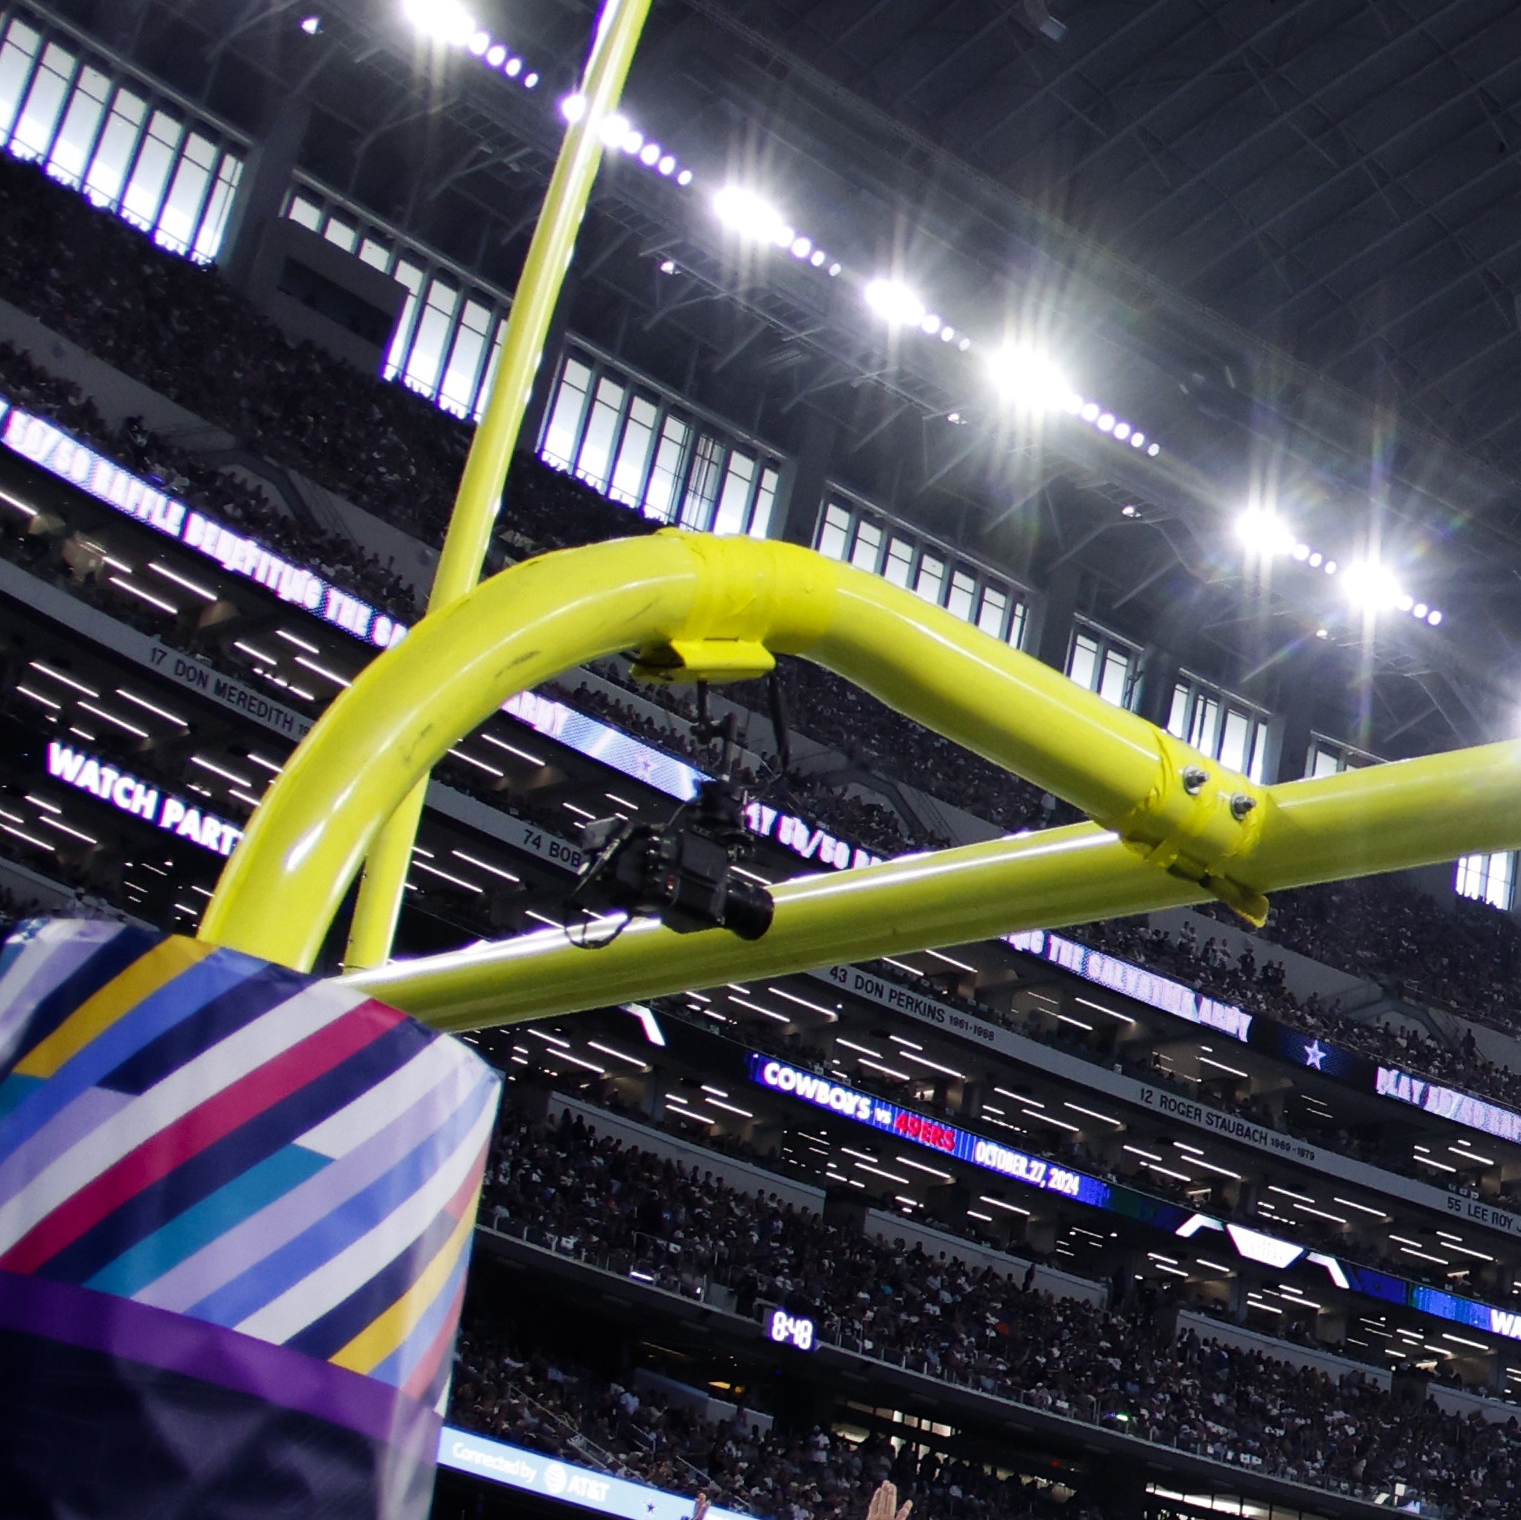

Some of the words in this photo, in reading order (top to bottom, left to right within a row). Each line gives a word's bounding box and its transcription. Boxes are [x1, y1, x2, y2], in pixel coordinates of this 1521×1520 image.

[150, 645, 167, 666] 17
[174, 658, 209, 690] DON
[214, 677, 296, 732] MEREDITH
[50, 741, 158, 820] WATCH
[523, 828, 543, 850] 74
[549, 839, 584, 869] BOB
[829, 965, 848, 983] 43
[854, 975, 884, 1000] DON
[888, 988, 946, 1023] PERKINS
[1376, 1066, 1431, 1105] PLAY
[763, 1061, 874, 1120] COWBOYS
[895, 1109, 957, 1152] 49ERS
[1049, 1166, 1082, 1196] 2024
[1139, 1087, 1154, 1105] 12
[1160, 1094, 1203, 1123] ROGER
[1205, 1111, 1269, 1146] STAUBACH
[1447, 1199, 1461, 1213] 55
[1467, 1202, 1489, 1222] LEE
[1491, 1211, 1514, 1229] ROY
[772, 1311, 813, 1350] 8:48
[451, 1441, 521, 1479] Connected
[566, 1473, 611, 1502] AT&T
